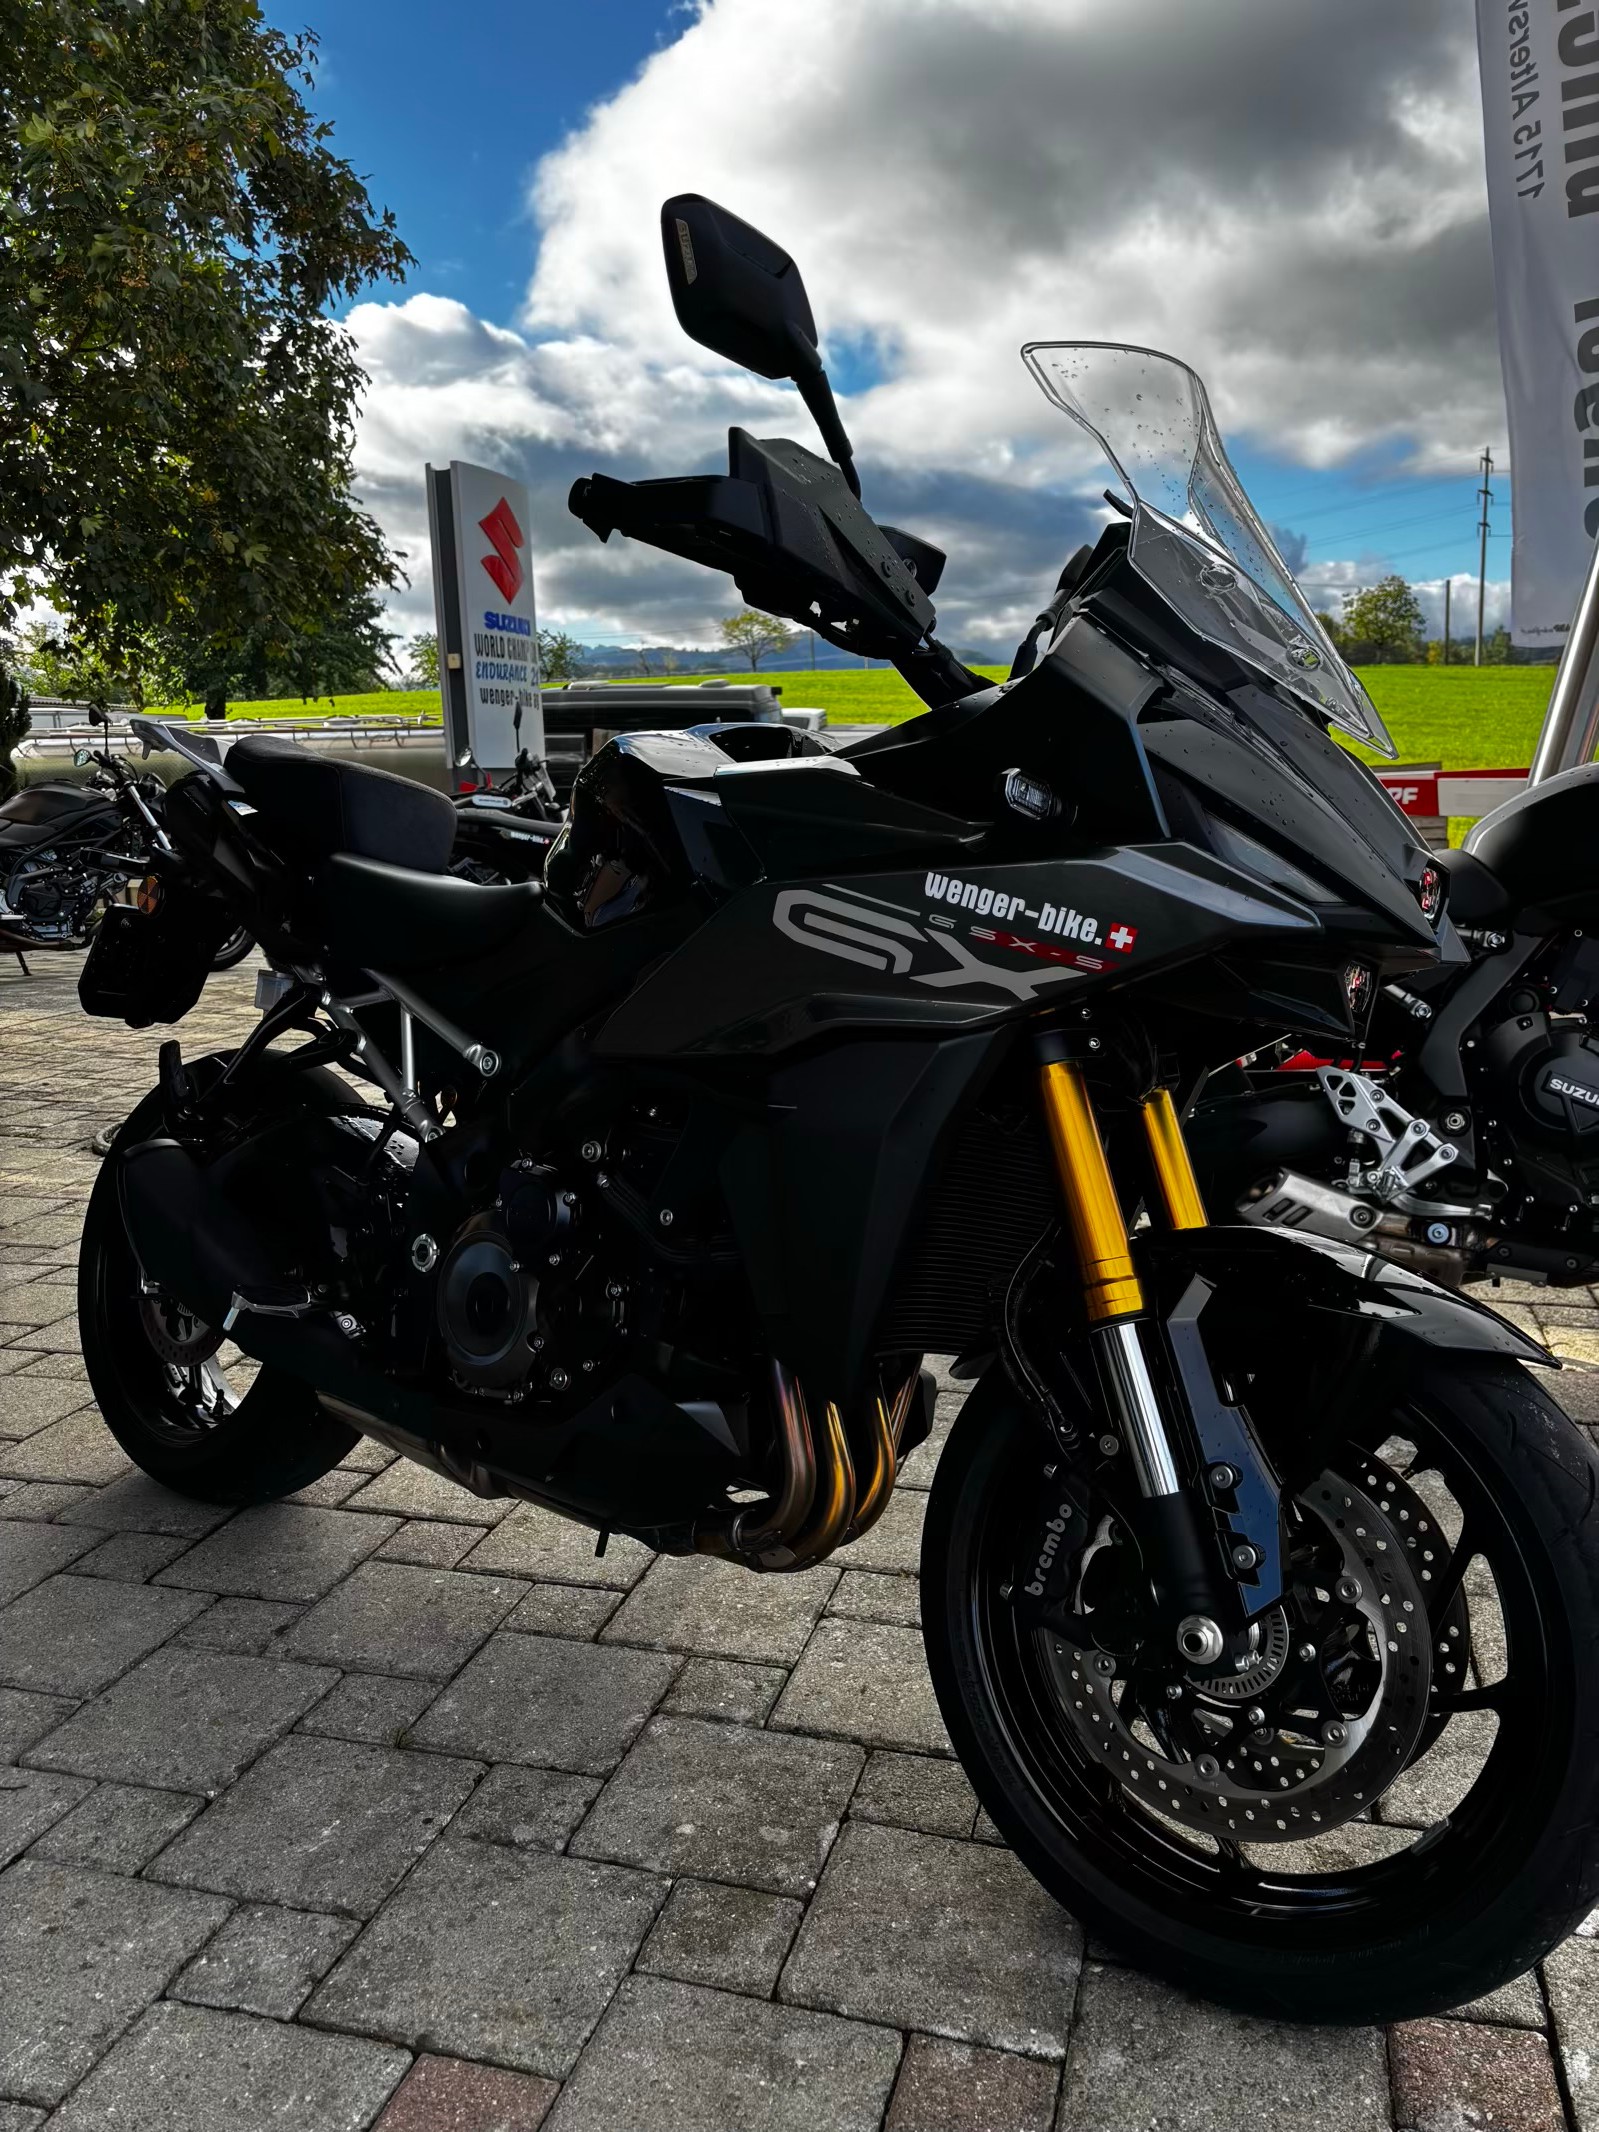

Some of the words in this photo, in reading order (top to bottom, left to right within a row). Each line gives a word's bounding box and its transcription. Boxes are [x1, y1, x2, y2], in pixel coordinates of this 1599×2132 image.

[484, 611, 531, 636] SUZUKI
[474, 633, 505, 658] WORLD
[476, 661, 527, 683] ENDURANCE
[1549, 1078, 1599, 1106] SUZU
[1024, 1503, 1072, 1596] brembo
